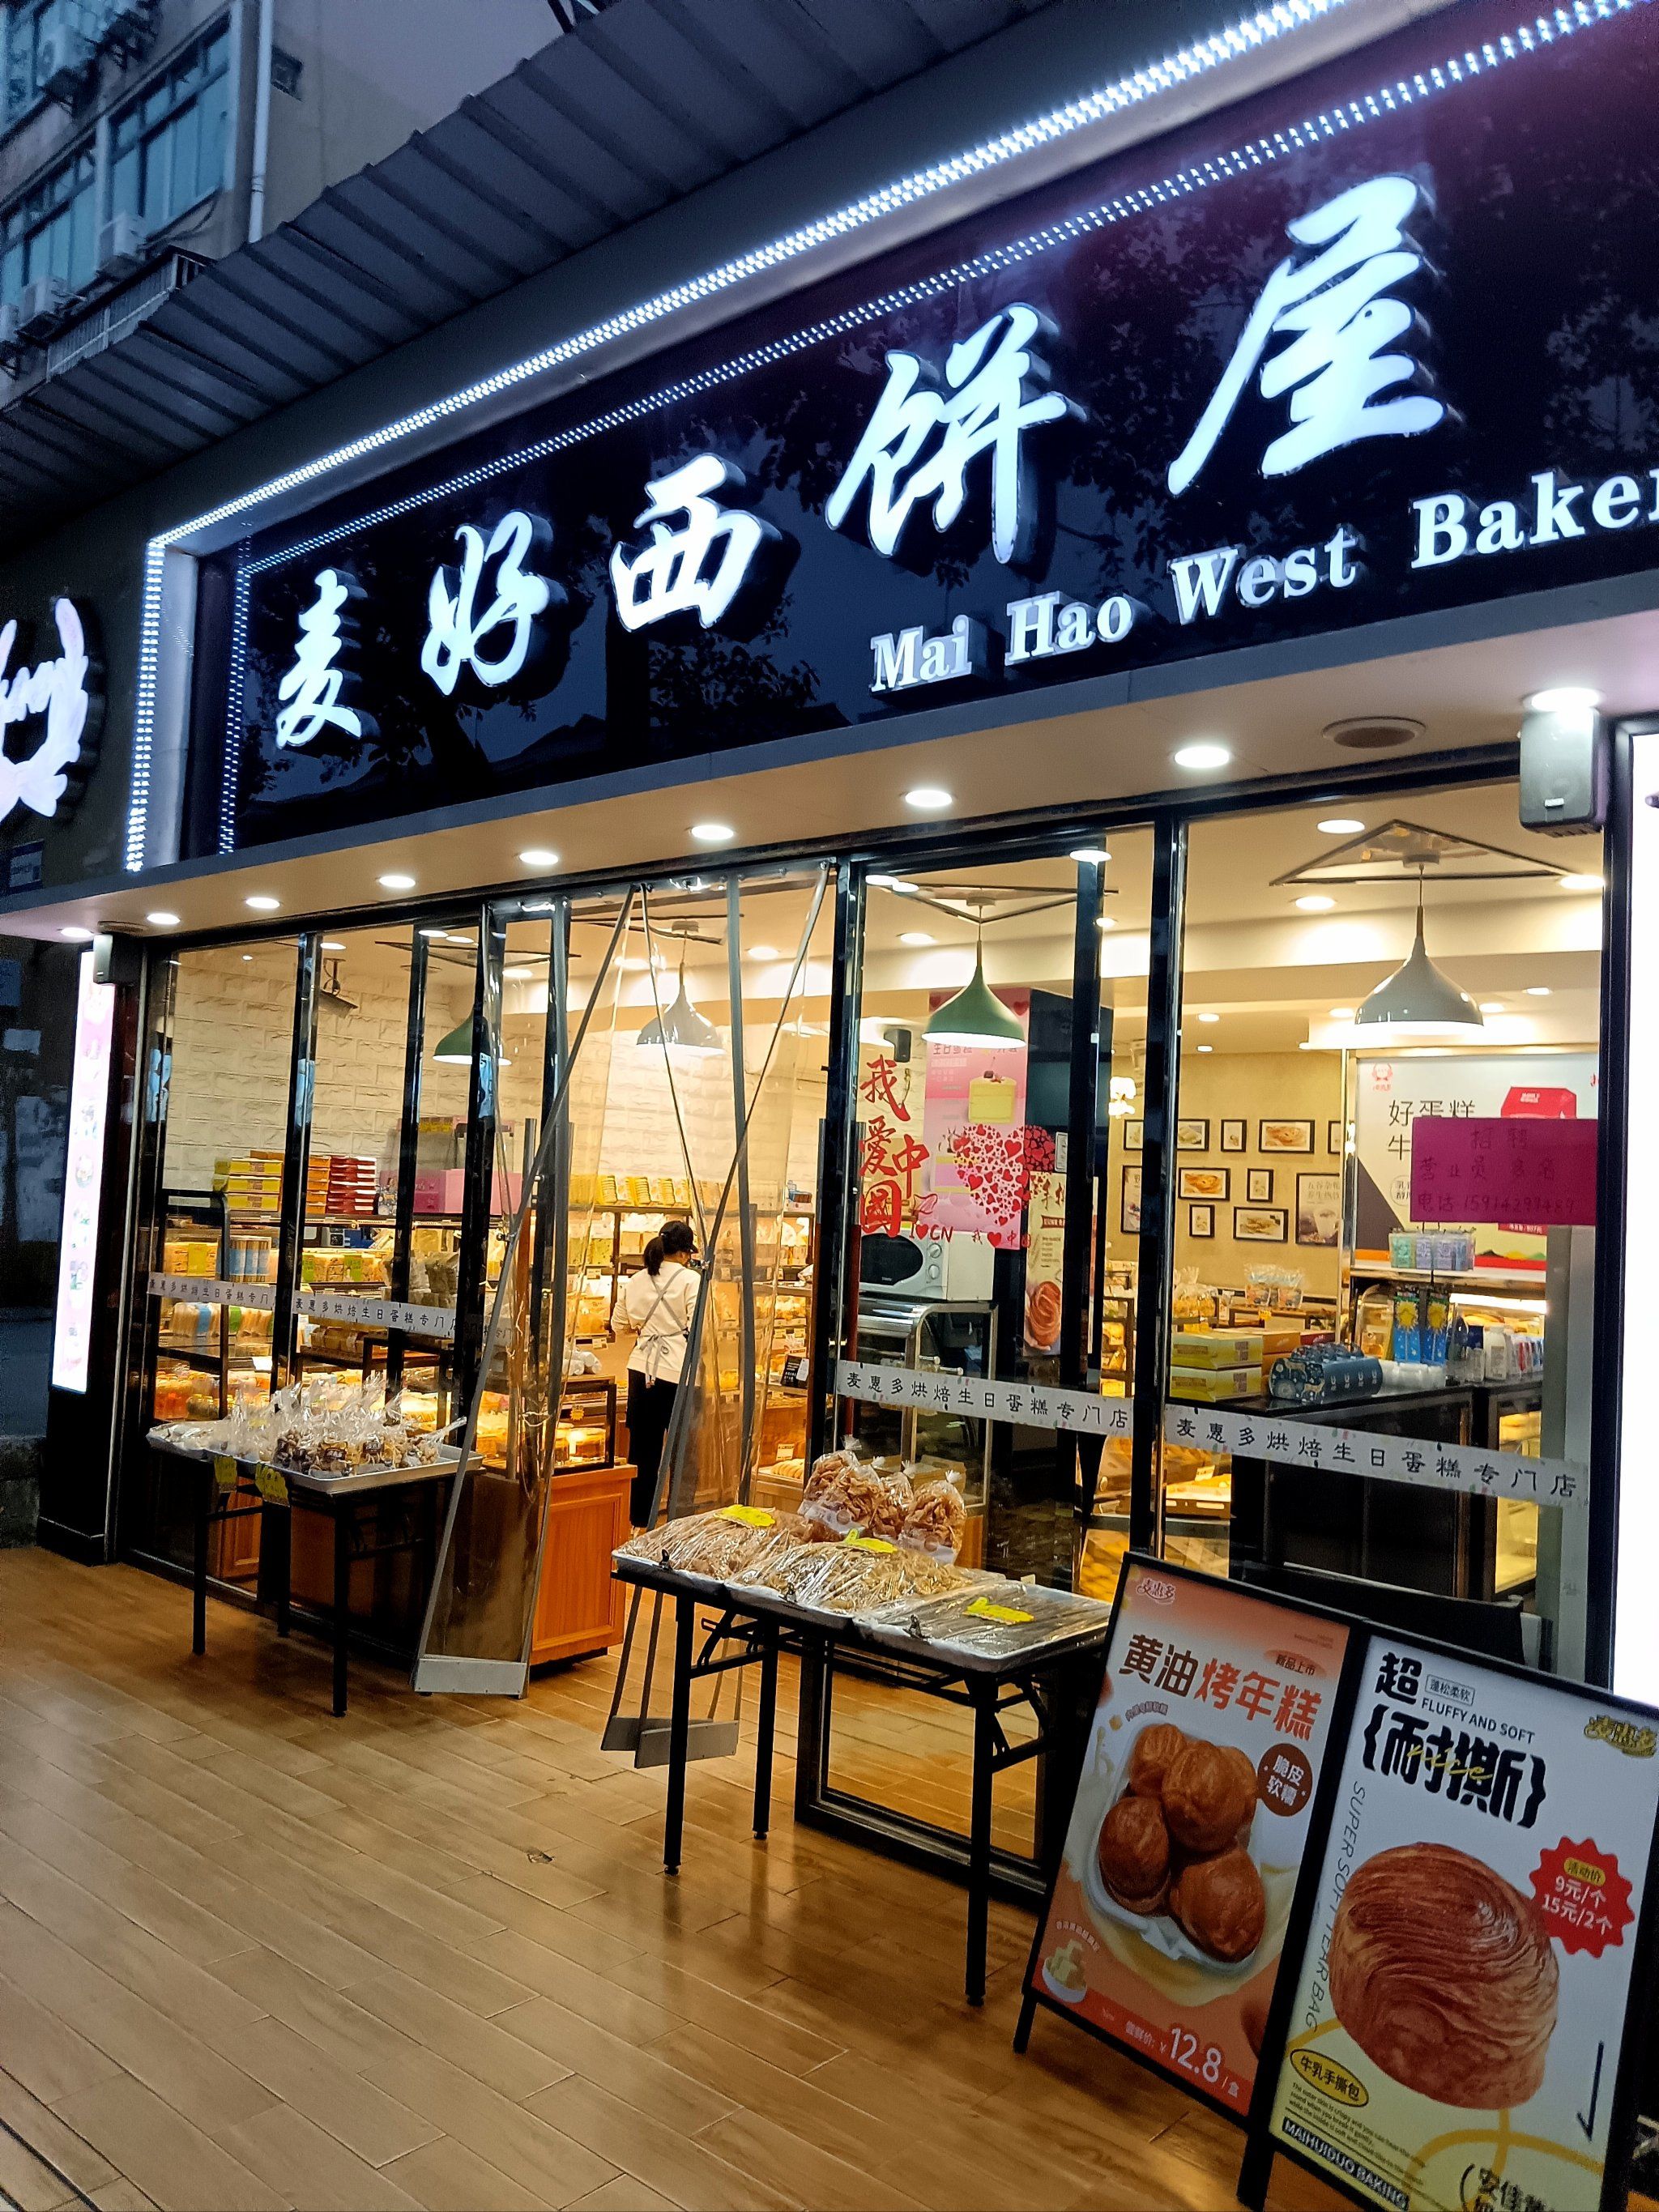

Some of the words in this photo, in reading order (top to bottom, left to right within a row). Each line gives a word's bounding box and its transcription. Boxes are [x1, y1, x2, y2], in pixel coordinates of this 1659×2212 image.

[275, 175, 1446, 749] 麦好西饼屋
[870, 615, 972, 693] Mai
[1004, 591, 1134, 666] Hao
[1168, 527, 1358, 624] West
[929, 1225, 953, 1243] CN
[149, 1277, 275, 1307] 麦惠多烘焙生日蛋糕专门
[847, 1371, 1128, 1429] 麦惠多烘焙生日蛋糕专门店
[1175, 1417, 1577, 1498] 麦惠多烘焙生日蛋糕专门店
[1119, 1634, 1322, 1741] 黄油烤年糕
[1375, 1652, 1422, 1705] 超
[1421, 1697, 1469, 1723] FLUFFY
[1469, 1714, 1497, 1733] AND
[1499, 1723, 1536, 1745] SOFT
[1342, 1780, 1366, 1859] SUPER
[1541, 1893, 1614, 1936] 15元/2个
[1555, 1876, 1606, 1908] 9元/个
[1305, 1981, 1325, 2033] BAG
[1300, 2055, 1361, 2102] 牛乳手撕包
